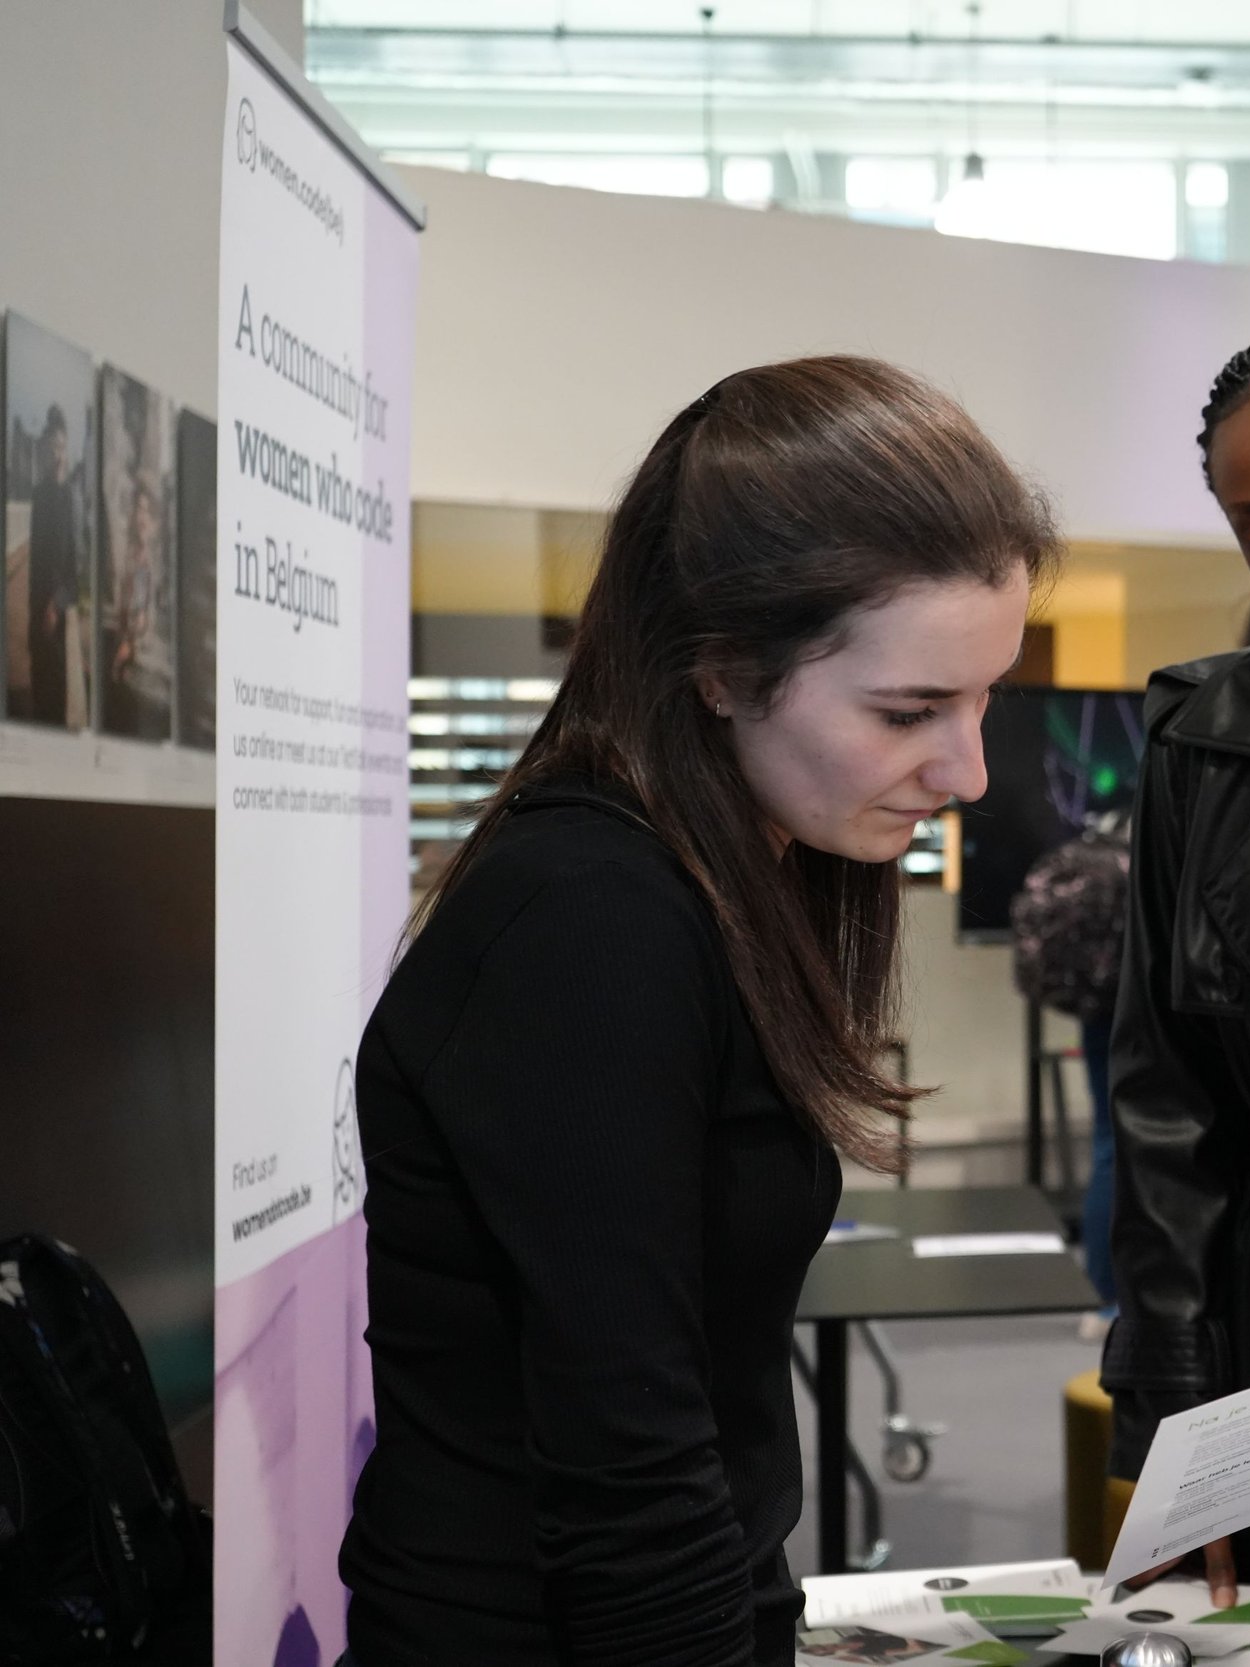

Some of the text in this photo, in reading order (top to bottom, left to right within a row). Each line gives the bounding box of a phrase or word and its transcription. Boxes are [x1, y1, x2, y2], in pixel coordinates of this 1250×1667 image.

[235, 283, 389, 442] A community for
[234, 420, 393, 544] women who code
[234, 520, 340, 634] in Belgium
[233, 677, 258, 707] Your
[233, 735, 247, 757] us
[249, 732, 275, 761] online
[233, 785, 273, 810] connect
[233, 1158, 255, 1191] Find
[1188, 1416, 1219, 1432] Na
[1226, 1406, 1248, 1420] je
